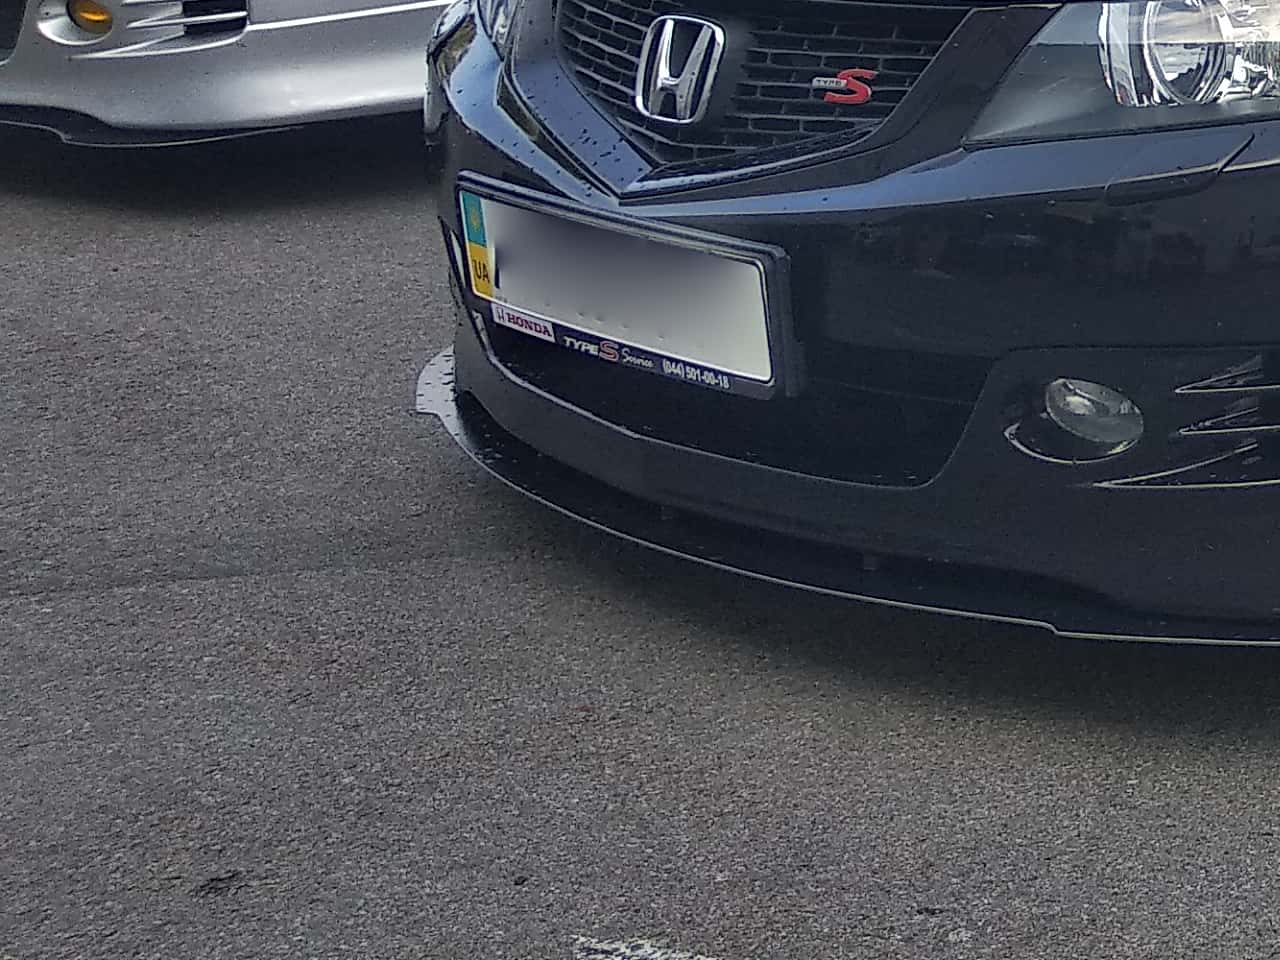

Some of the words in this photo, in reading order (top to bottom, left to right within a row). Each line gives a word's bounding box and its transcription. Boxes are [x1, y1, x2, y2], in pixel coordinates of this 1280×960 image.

[823, 68, 879, 104] S
[473, 258, 491, 284] UA
[506, 312, 553, 338] HONDA
[563, 336, 600, 356] TYPE
[599, 341, 620, 363] S
